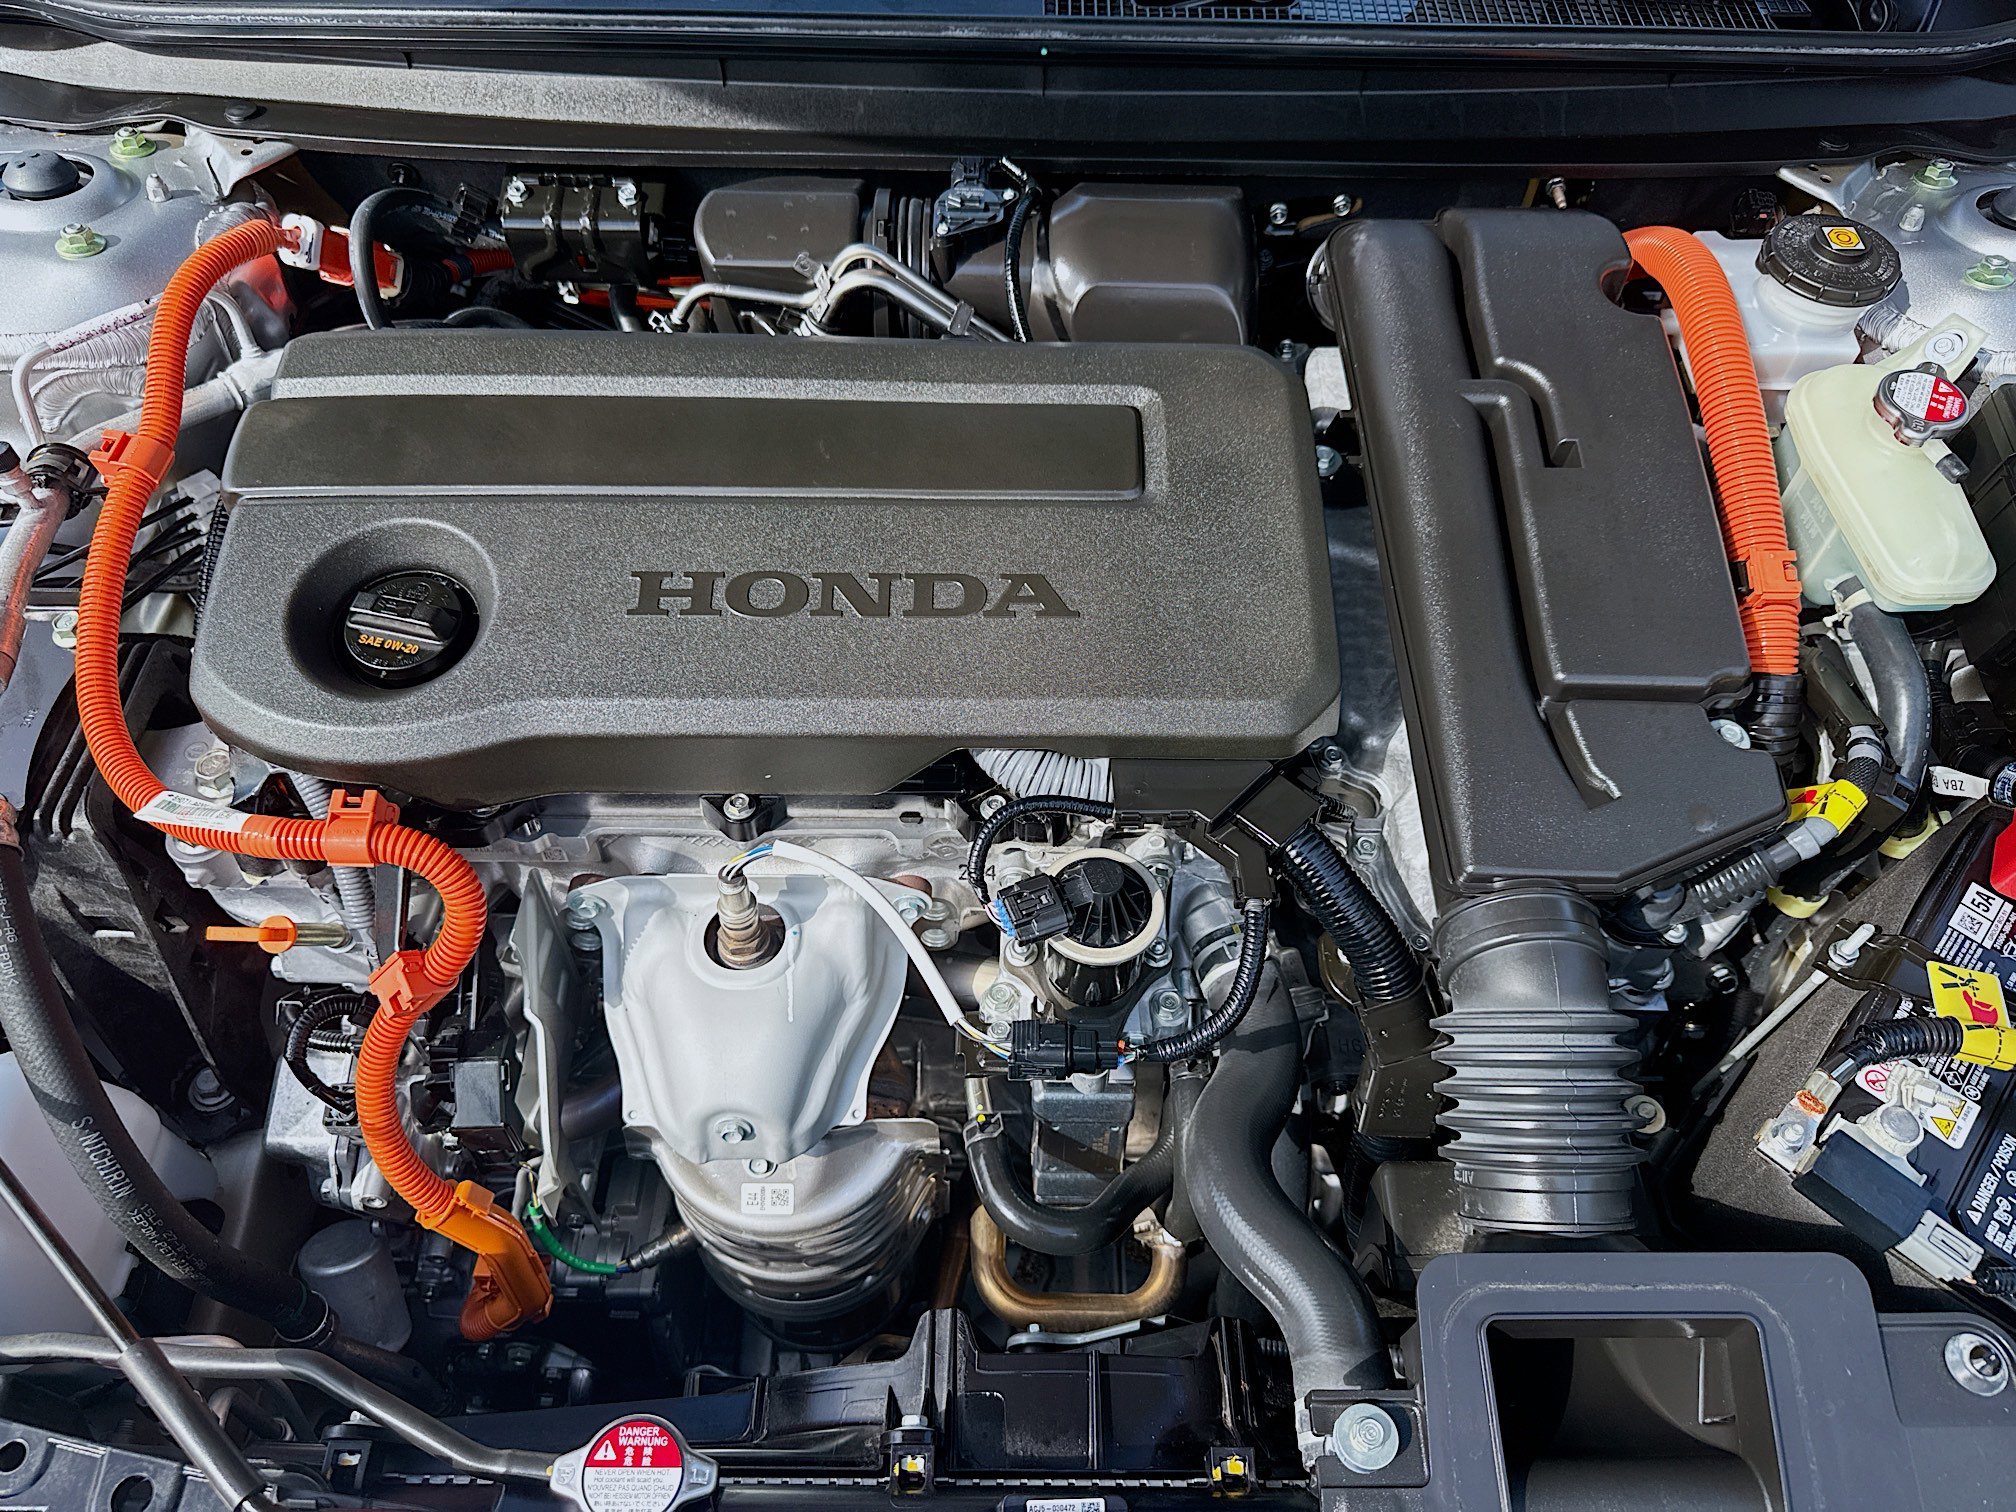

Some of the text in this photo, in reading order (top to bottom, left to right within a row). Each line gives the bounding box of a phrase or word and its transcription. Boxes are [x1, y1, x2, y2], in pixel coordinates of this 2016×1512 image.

[625, 570, 1081, 619] HONDA
[358, 634, 383, 648] SAE
[384, 640, 419, 654] 0W-20
[1970, 890, 1996, 913] 5A
[619, 1426, 660, 1437] DANGER
[618, 1436, 668, 1447] WARNUNG
[618, 1484, 630, 1492] PAS
[631, 1484, 652, 1492] QUAND
